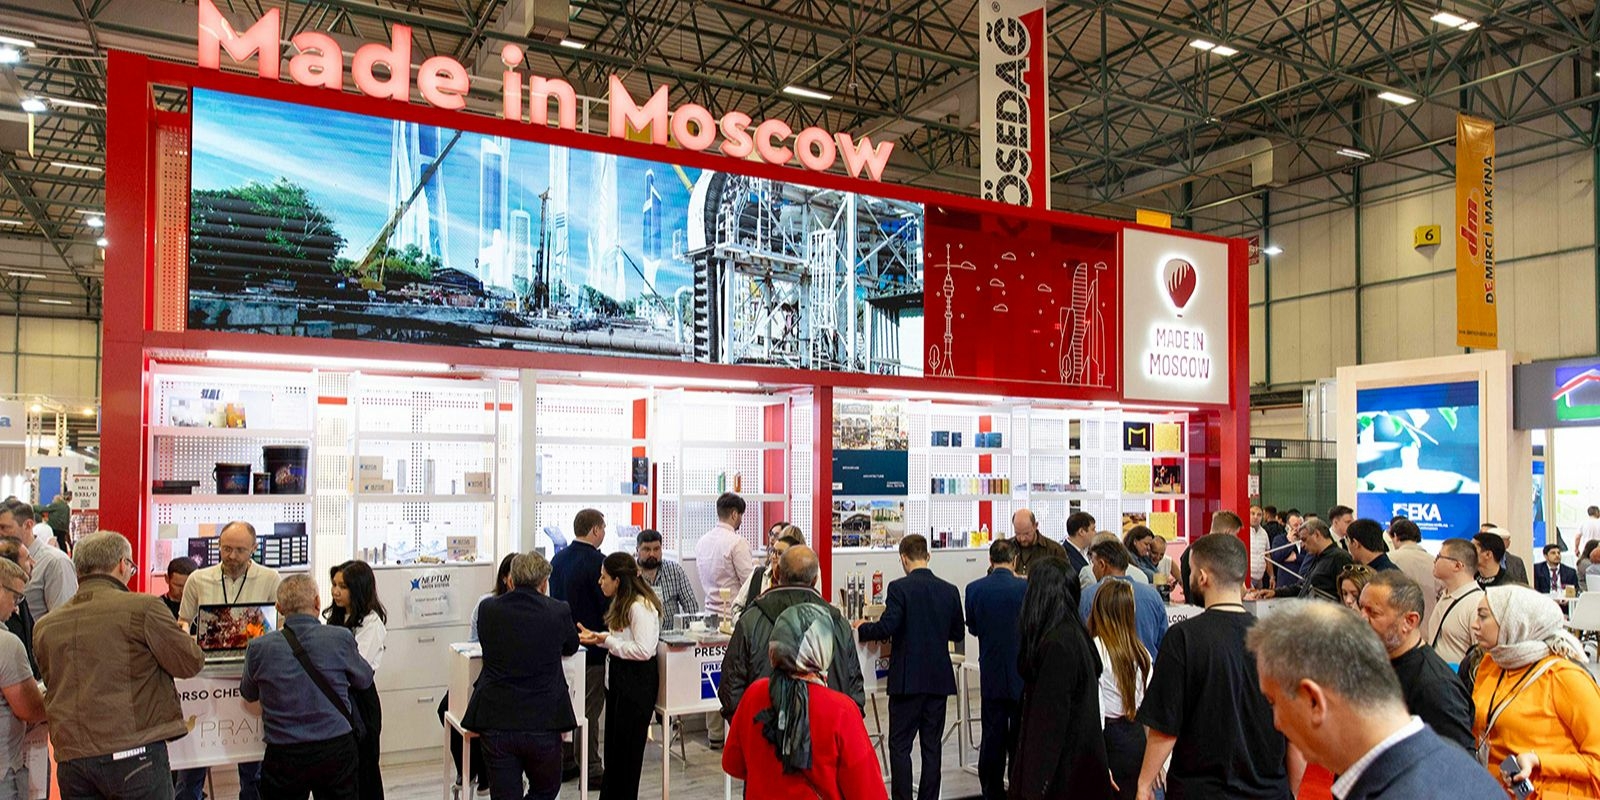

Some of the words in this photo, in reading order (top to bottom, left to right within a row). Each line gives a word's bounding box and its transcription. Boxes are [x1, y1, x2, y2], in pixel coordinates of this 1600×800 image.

[198, 0, 470, 110] Made
[501, 43, 577, 131] in
[608, 74, 895, 182] Moscow
[984, 16, 1030, 208] ÖSEDAĞ
[1482, 155, 1494, 226] MAKİNA
[1425, 228, 1434, 241] 6
[1483, 232, 1494, 304] DEMİRCİ
[1156, 328, 1189, 349] MADE
[1193, 332, 1204, 351] IN
[1150, 353, 1210, 379] MOSCOW
[421, 574, 451, 584] NEPTUN
[178, 690, 209, 701] RSO
